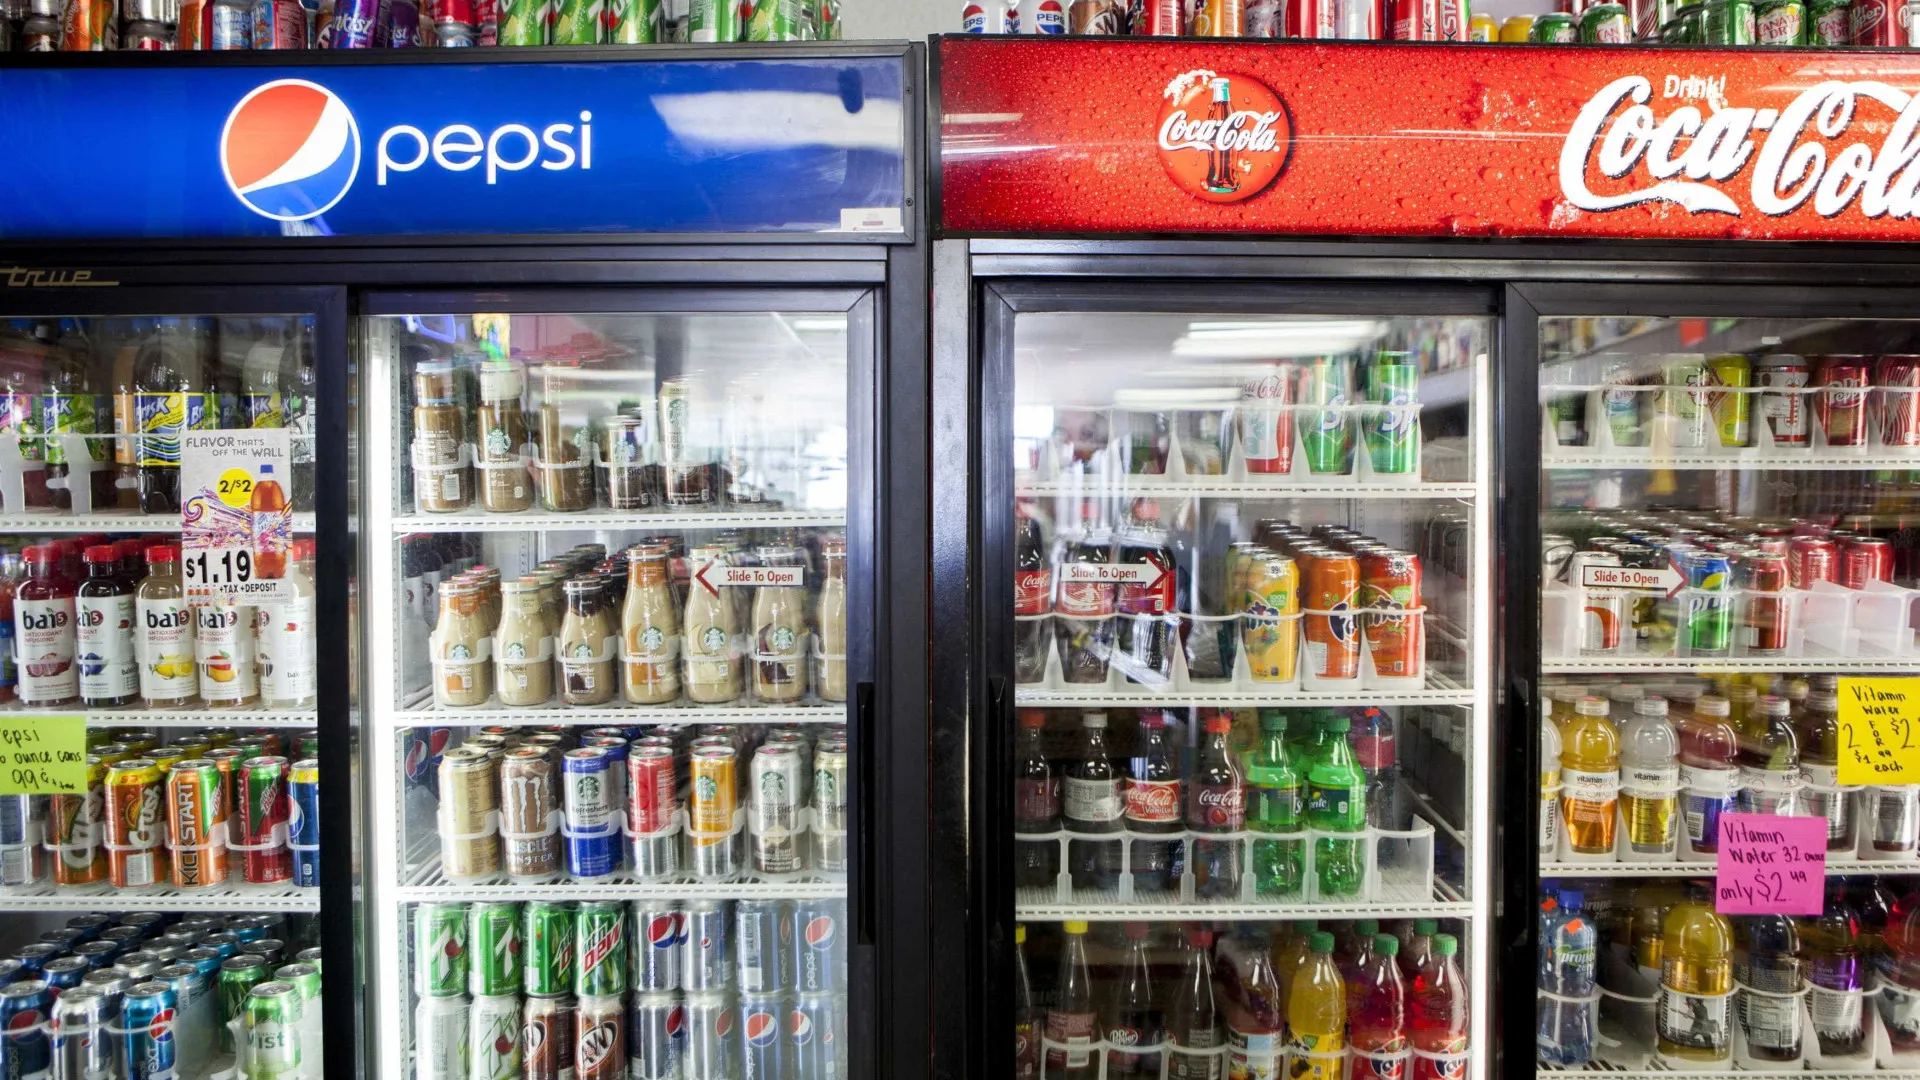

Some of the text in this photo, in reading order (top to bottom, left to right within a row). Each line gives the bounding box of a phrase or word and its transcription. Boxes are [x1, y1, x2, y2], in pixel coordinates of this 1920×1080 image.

[1663, 74, 1727, 100] Drink!
[1158, 109, 1281, 153] Coca-Cola
[377, 110, 592, 186] pepsi
[186, 436, 265, 448] FLAVOR THAT'S
[212, 447, 284, 458] OFF THE WALL
[219, 478, 252, 494] 2/$2
[186, 549, 251, 584] $1.19
[727, 570, 794, 584] Slide To Open
[1097, 567, 1108, 579] To
[1111, 567, 1138, 580] Open
[240, 582, 277, 593] +DEPOSIT
[1594, 570, 1659, 587] Slide To Open
[22, 607, 56, 630] bai
[146, 608, 180, 629] bai
[1851, 685, 1906, 702] Vitamin
[1862, 705, 1899, 716] Water
[0, 721, 40, 748] epsi
[1842, 723, 1861, 749] 2
[1874, 760, 1903, 772] each
[178, 781, 199, 886] KICKSTART
[1723, 820, 1784, 844] Vitamin
[1729, 847, 1776, 865] Water
[1783, 846, 1801, 862] 32
[1721, 879, 1753, 905] only
[804, 951, 818, 989] pepsi
